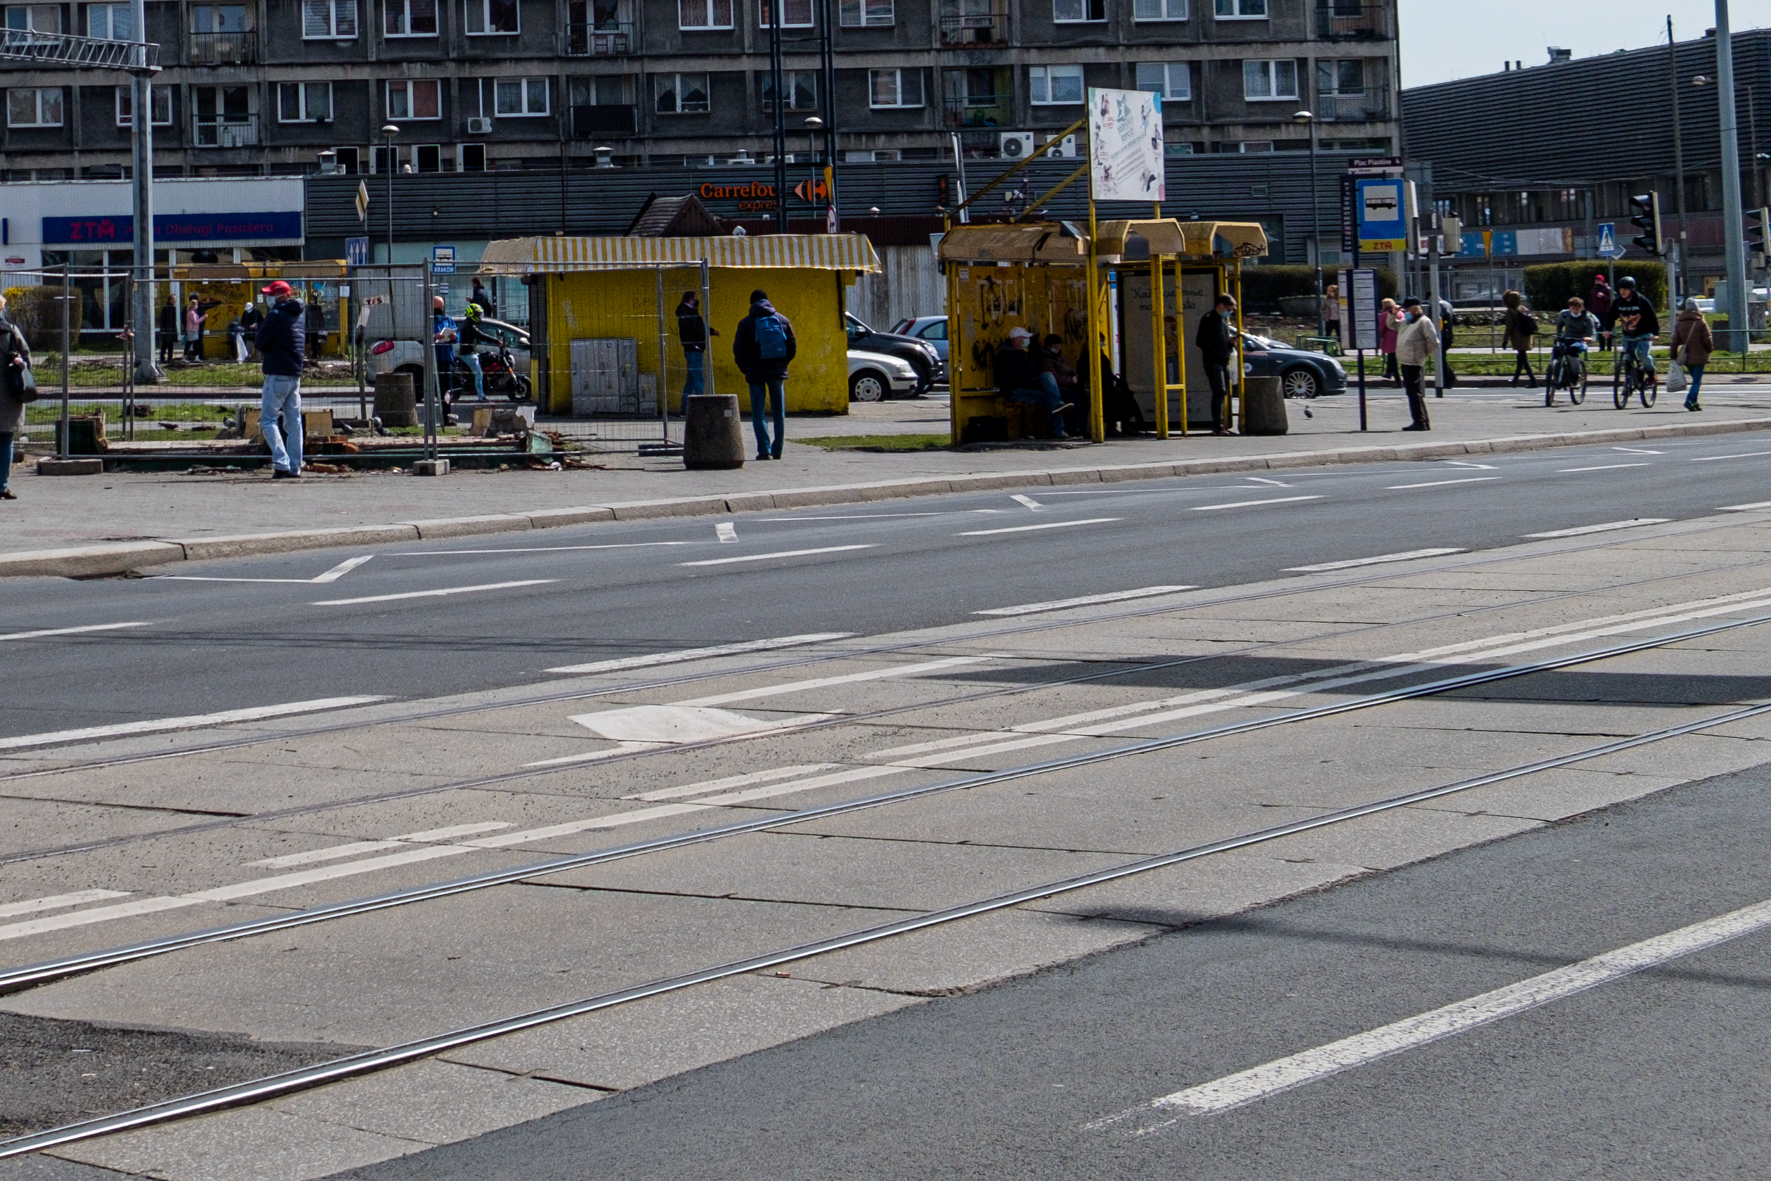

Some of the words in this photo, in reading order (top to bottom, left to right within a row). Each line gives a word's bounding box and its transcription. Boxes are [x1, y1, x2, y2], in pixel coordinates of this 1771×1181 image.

[700, 181, 776, 198] Carrefou
[70, 219, 115, 239] ZTM
[166, 223, 212, 237] Obsługi
[217, 222, 274, 233] Pasażera
